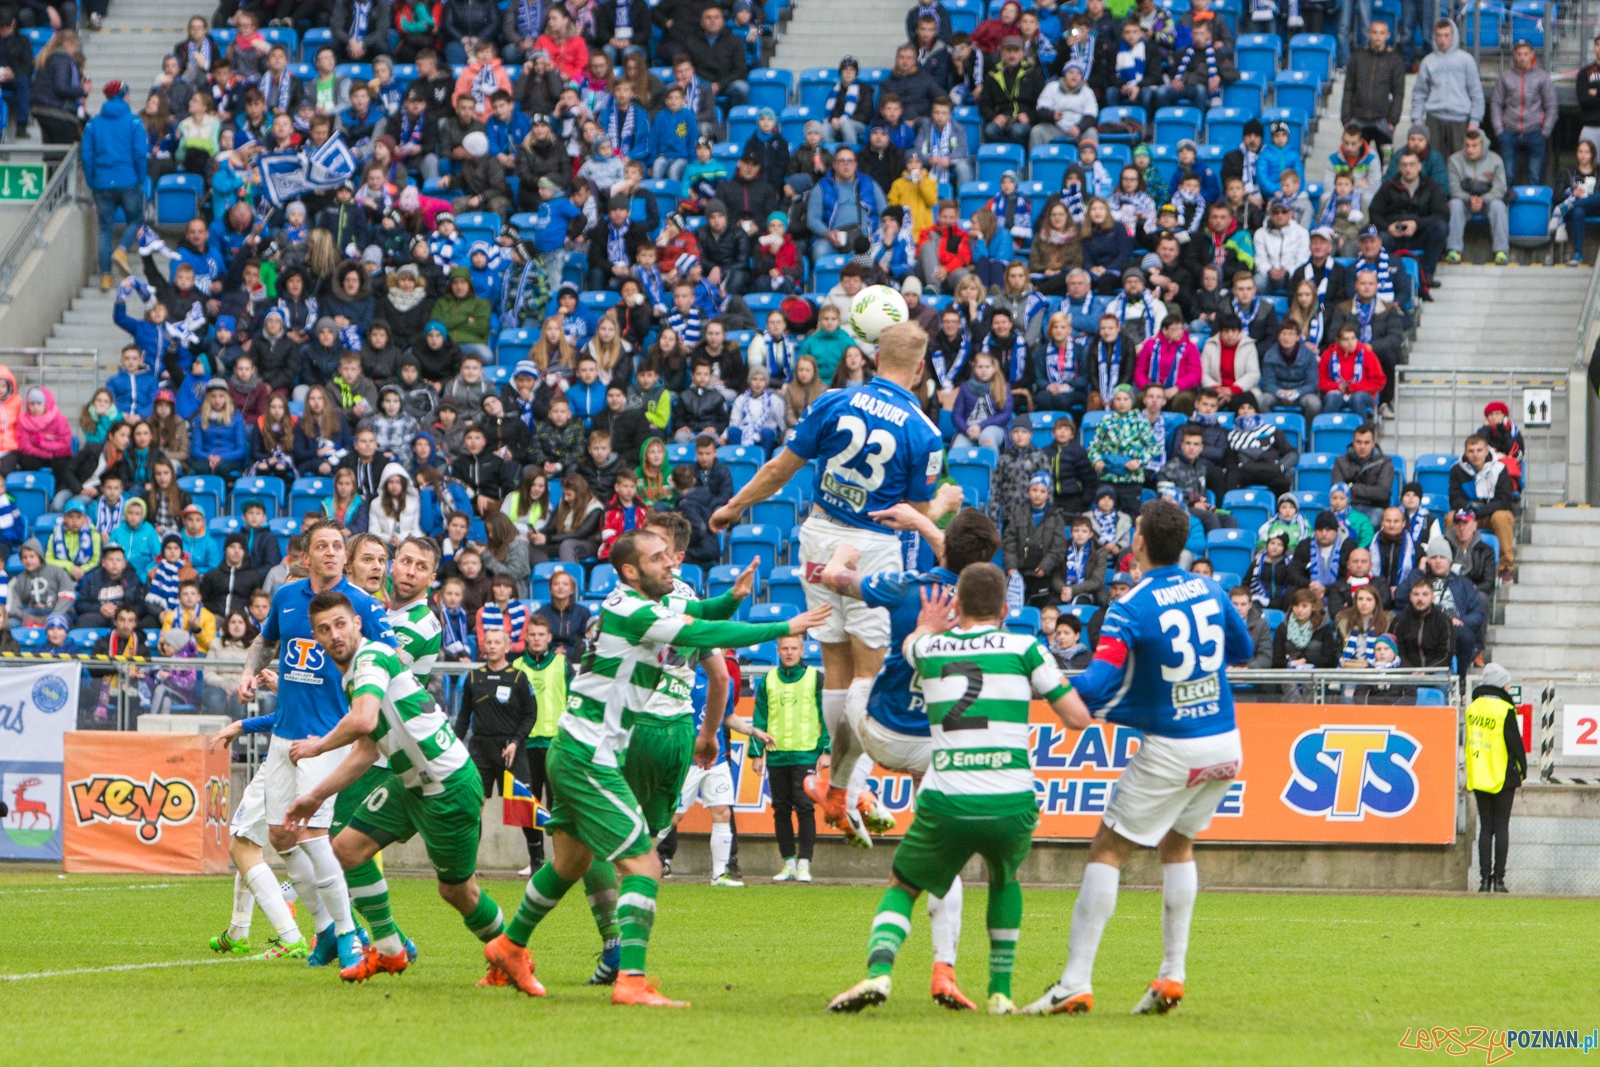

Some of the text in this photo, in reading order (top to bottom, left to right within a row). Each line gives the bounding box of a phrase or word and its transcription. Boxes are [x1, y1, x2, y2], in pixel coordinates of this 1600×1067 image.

[849, 392, 910, 427] ARAJUURI
[826, 415, 897, 492] 23
[284, 637, 326, 670] STS
[1158, 598, 1226, 683] 35
[941, 661, 989, 732] 2
[1176, 680, 1216, 704] LECH
[1172, 702, 1220, 721] PILS
[1576, 717, 1599, 745] 2
[952, 751, 1013, 768] Energa
[1281, 727, 1422, 820] STS
